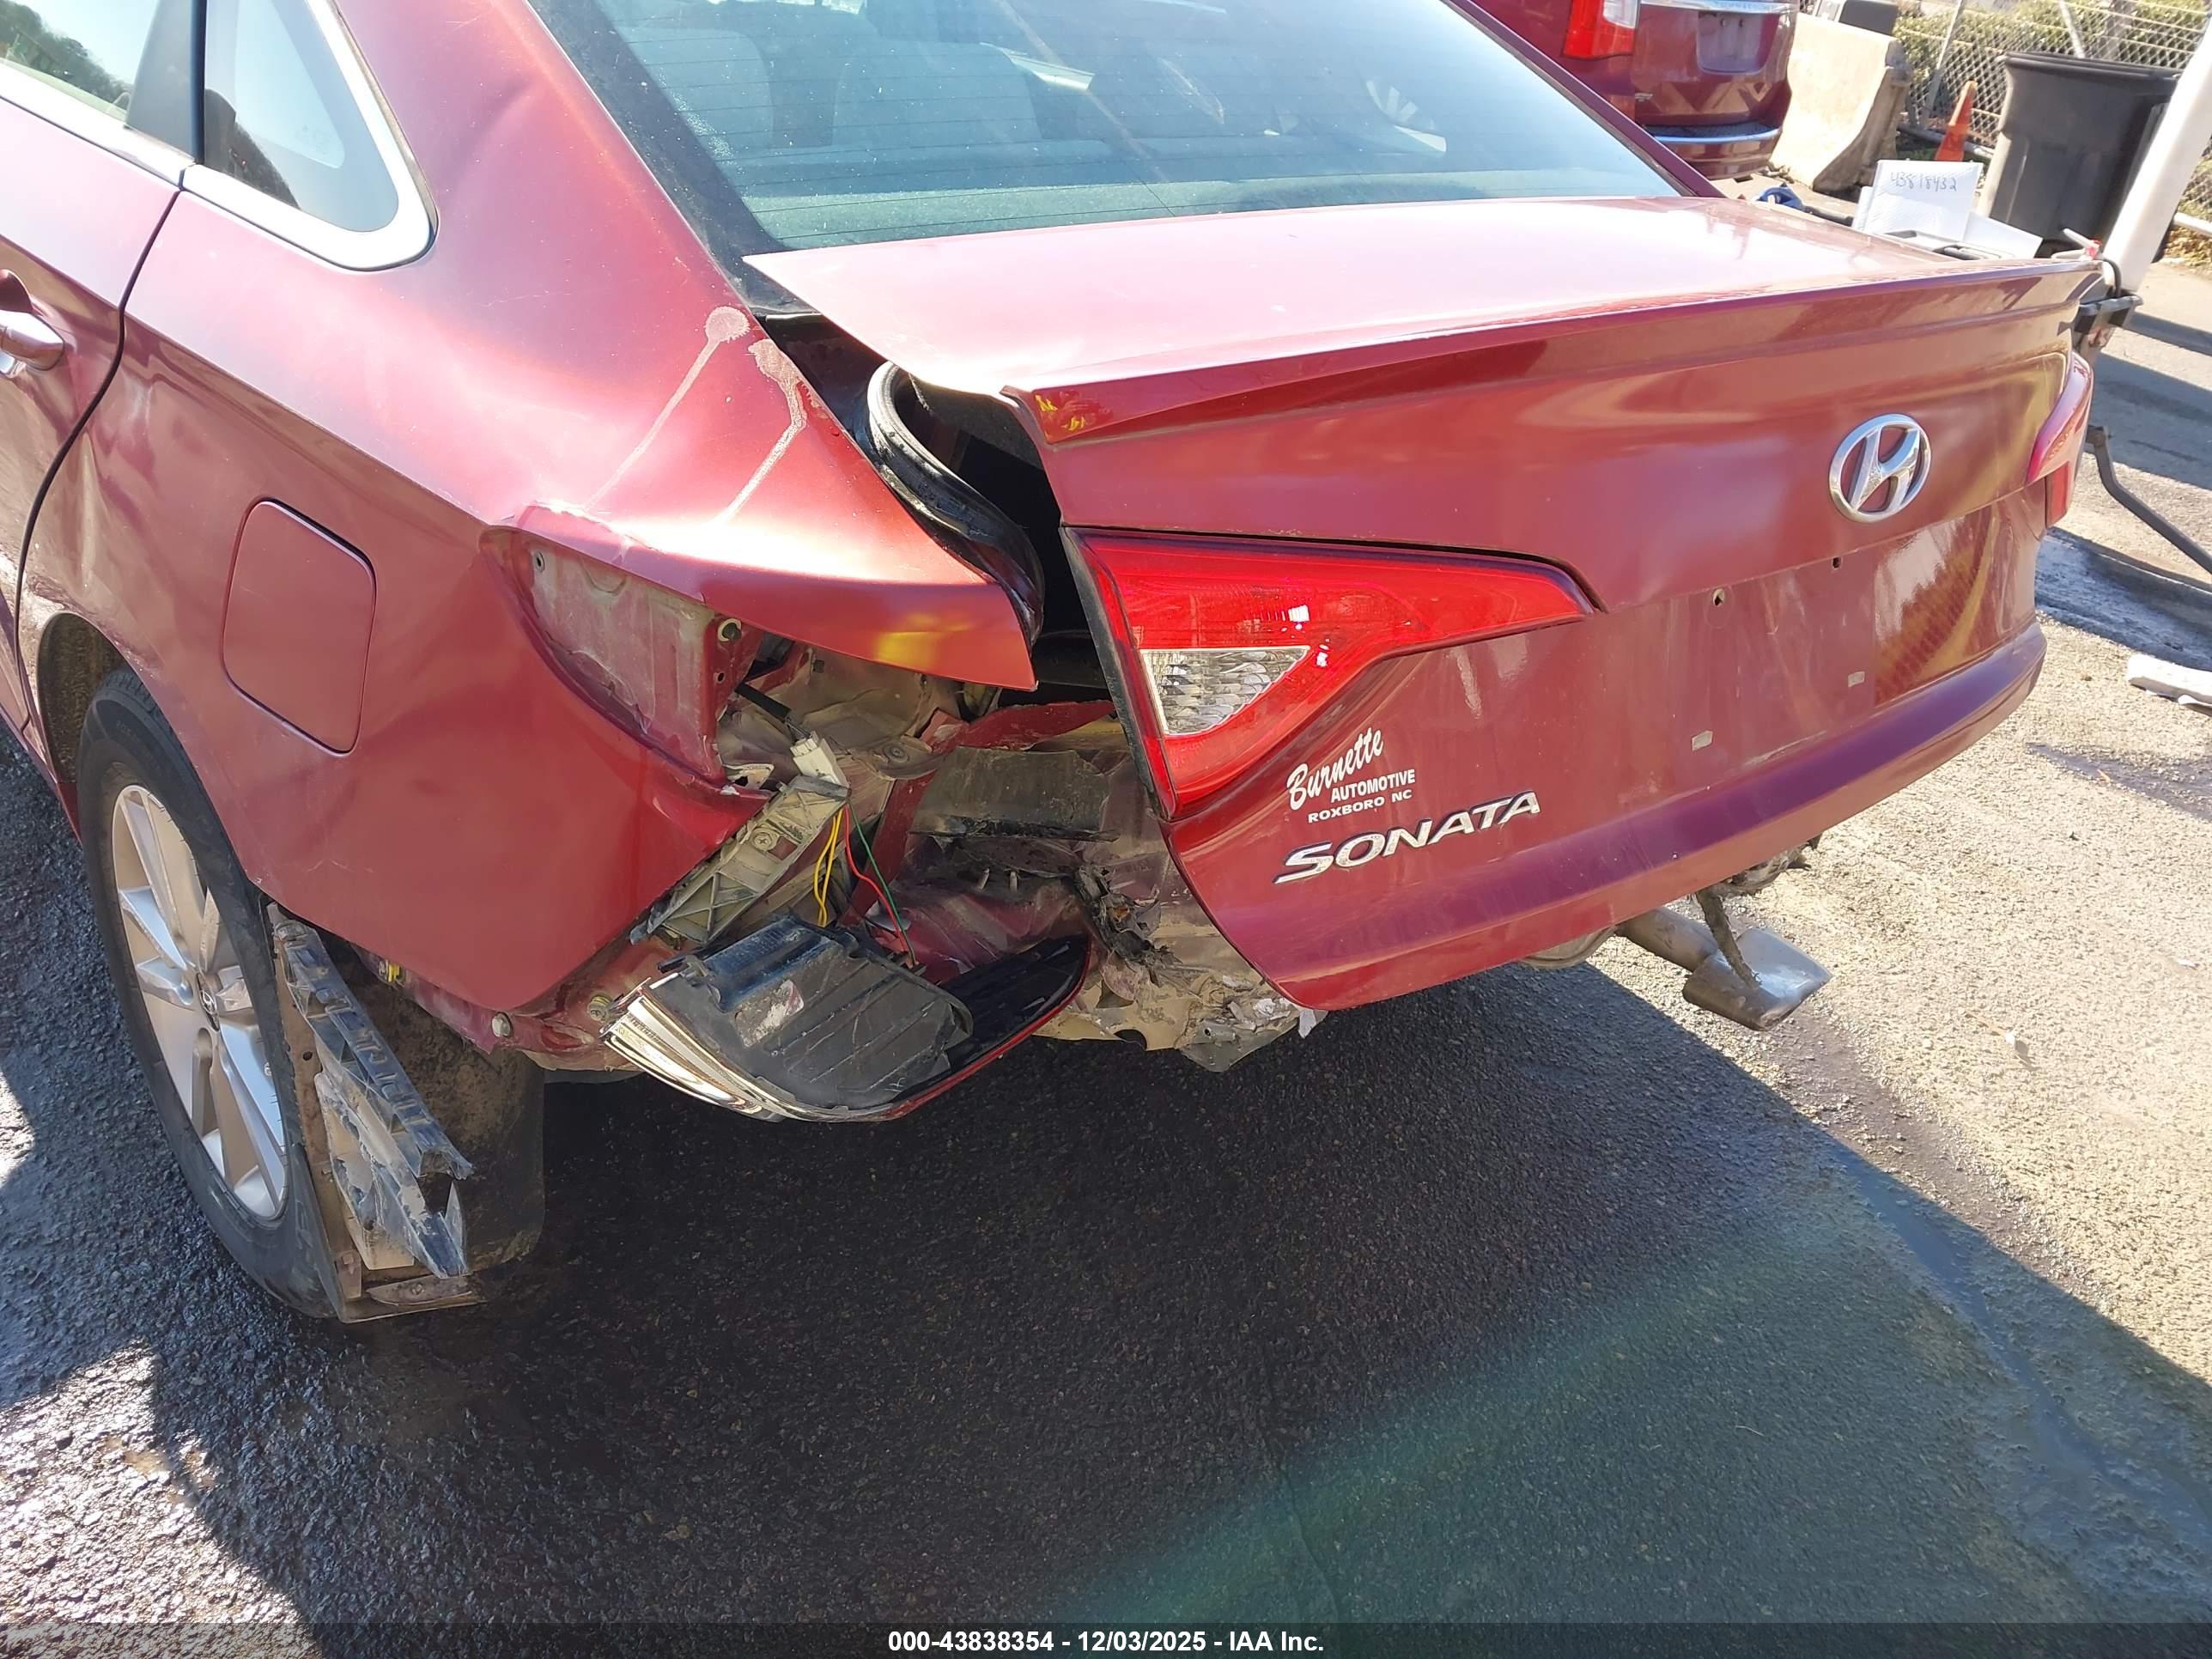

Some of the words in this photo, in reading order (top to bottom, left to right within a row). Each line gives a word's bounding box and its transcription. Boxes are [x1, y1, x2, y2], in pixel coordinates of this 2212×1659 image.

[1286, 727, 1383, 810] Burnette
[1331, 769, 1415, 804] AUTOMOTIVE
[1308, 797, 1385, 823] ROXBORO
[1391, 789, 1413, 802] NC
[1272, 790, 1540, 884] SONATA
